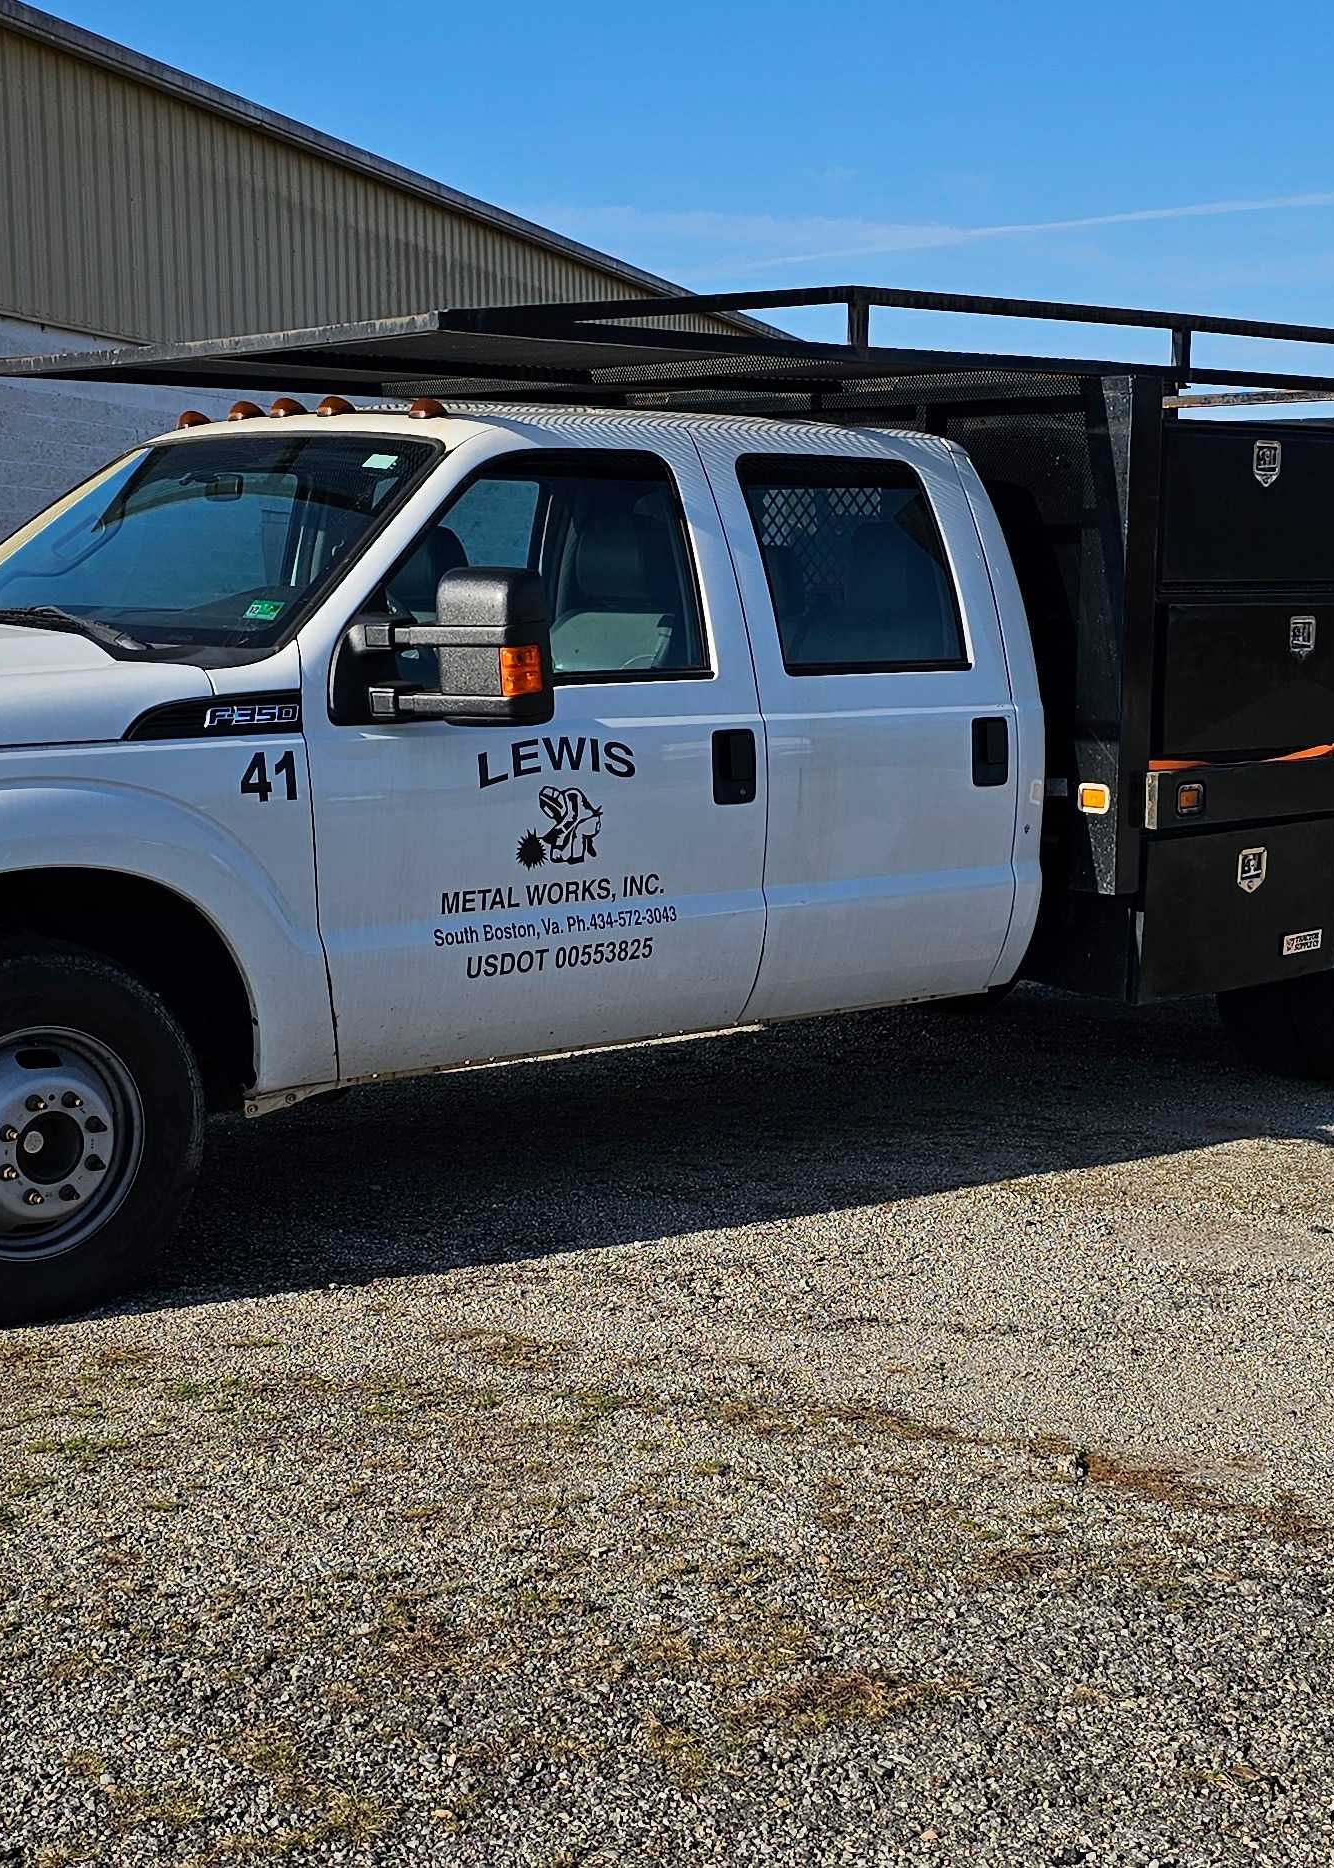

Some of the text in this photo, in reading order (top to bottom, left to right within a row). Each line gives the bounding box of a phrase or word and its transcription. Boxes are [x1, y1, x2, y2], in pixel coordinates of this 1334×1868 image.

[204, 704, 300, 728] F-350
[240, 750, 299, 802] 41
[478, 737, 636, 789] LEWIS
[441, 873, 665, 914] METAL WORKS, INC.
[434, 926, 479, 947] South
[483, 921, 541, 942] Boston,
[542, 917, 564, 935] Va.
[467, 937, 653, 978] USDOT 00553825
